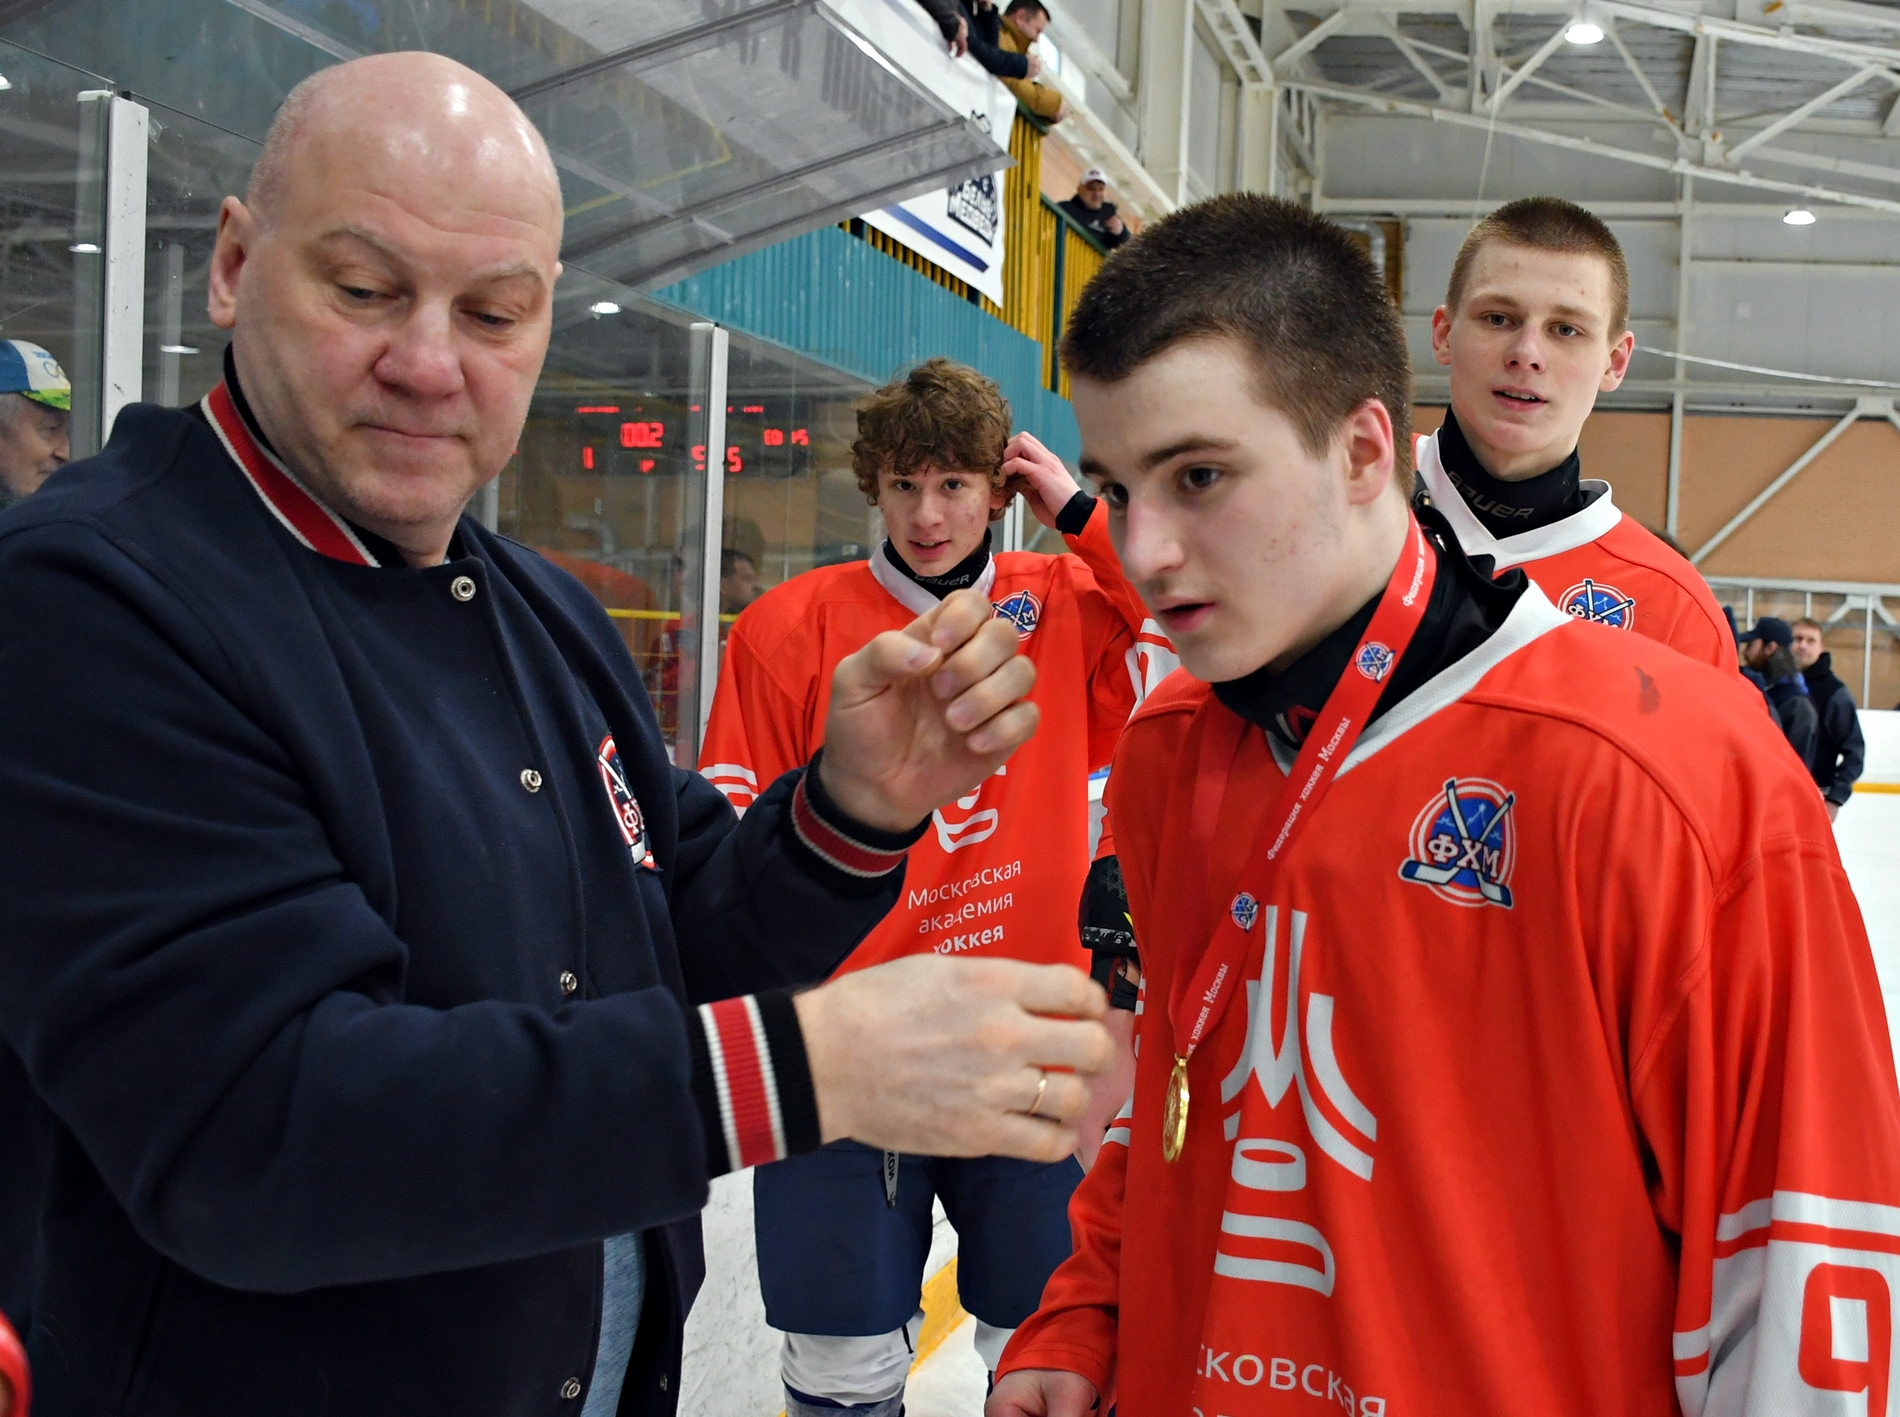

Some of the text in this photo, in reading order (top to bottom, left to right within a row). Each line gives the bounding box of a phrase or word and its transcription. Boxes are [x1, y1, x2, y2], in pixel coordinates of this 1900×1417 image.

[1010, 609, 1036, 627] ХМ
[1267, 717, 1351, 860] Федерация хоккея Москвы
[1427, 833, 1501, 878] ФХМ
[907, 859, 1022, 910] Московская
[918, 891, 1014, 934] академия
[932, 925, 1005, 956] хоккея
[1191, 1005, 1211, 1041] хоккея
[1203, 963, 1229, 1004] Москвы
[1197, 1343, 1386, 1417] ковская
